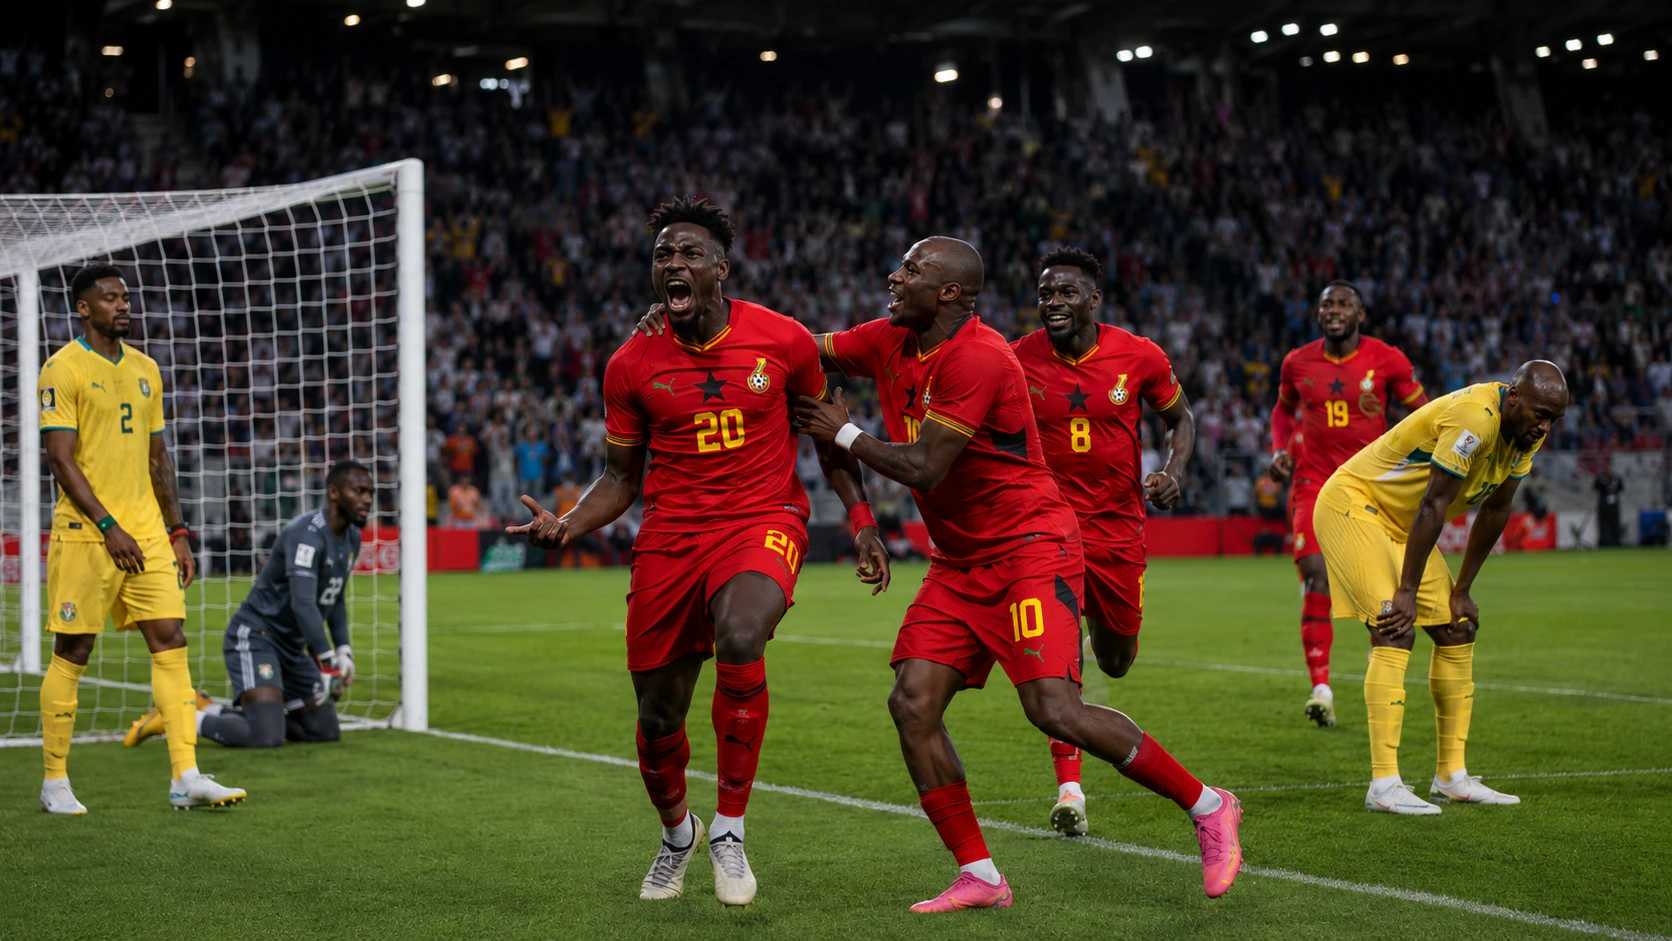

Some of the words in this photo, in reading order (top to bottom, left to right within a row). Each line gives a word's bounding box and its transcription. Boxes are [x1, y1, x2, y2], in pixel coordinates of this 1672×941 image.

[120, 402, 134, 434] 2
[694, 408, 745, 452] 20
[1325, 400, 1348, 427] 19
[1070, 417, 1091, 453] 8
[765, 529, 799, 575] 20
[1009, 597, 1044, 642] 10
